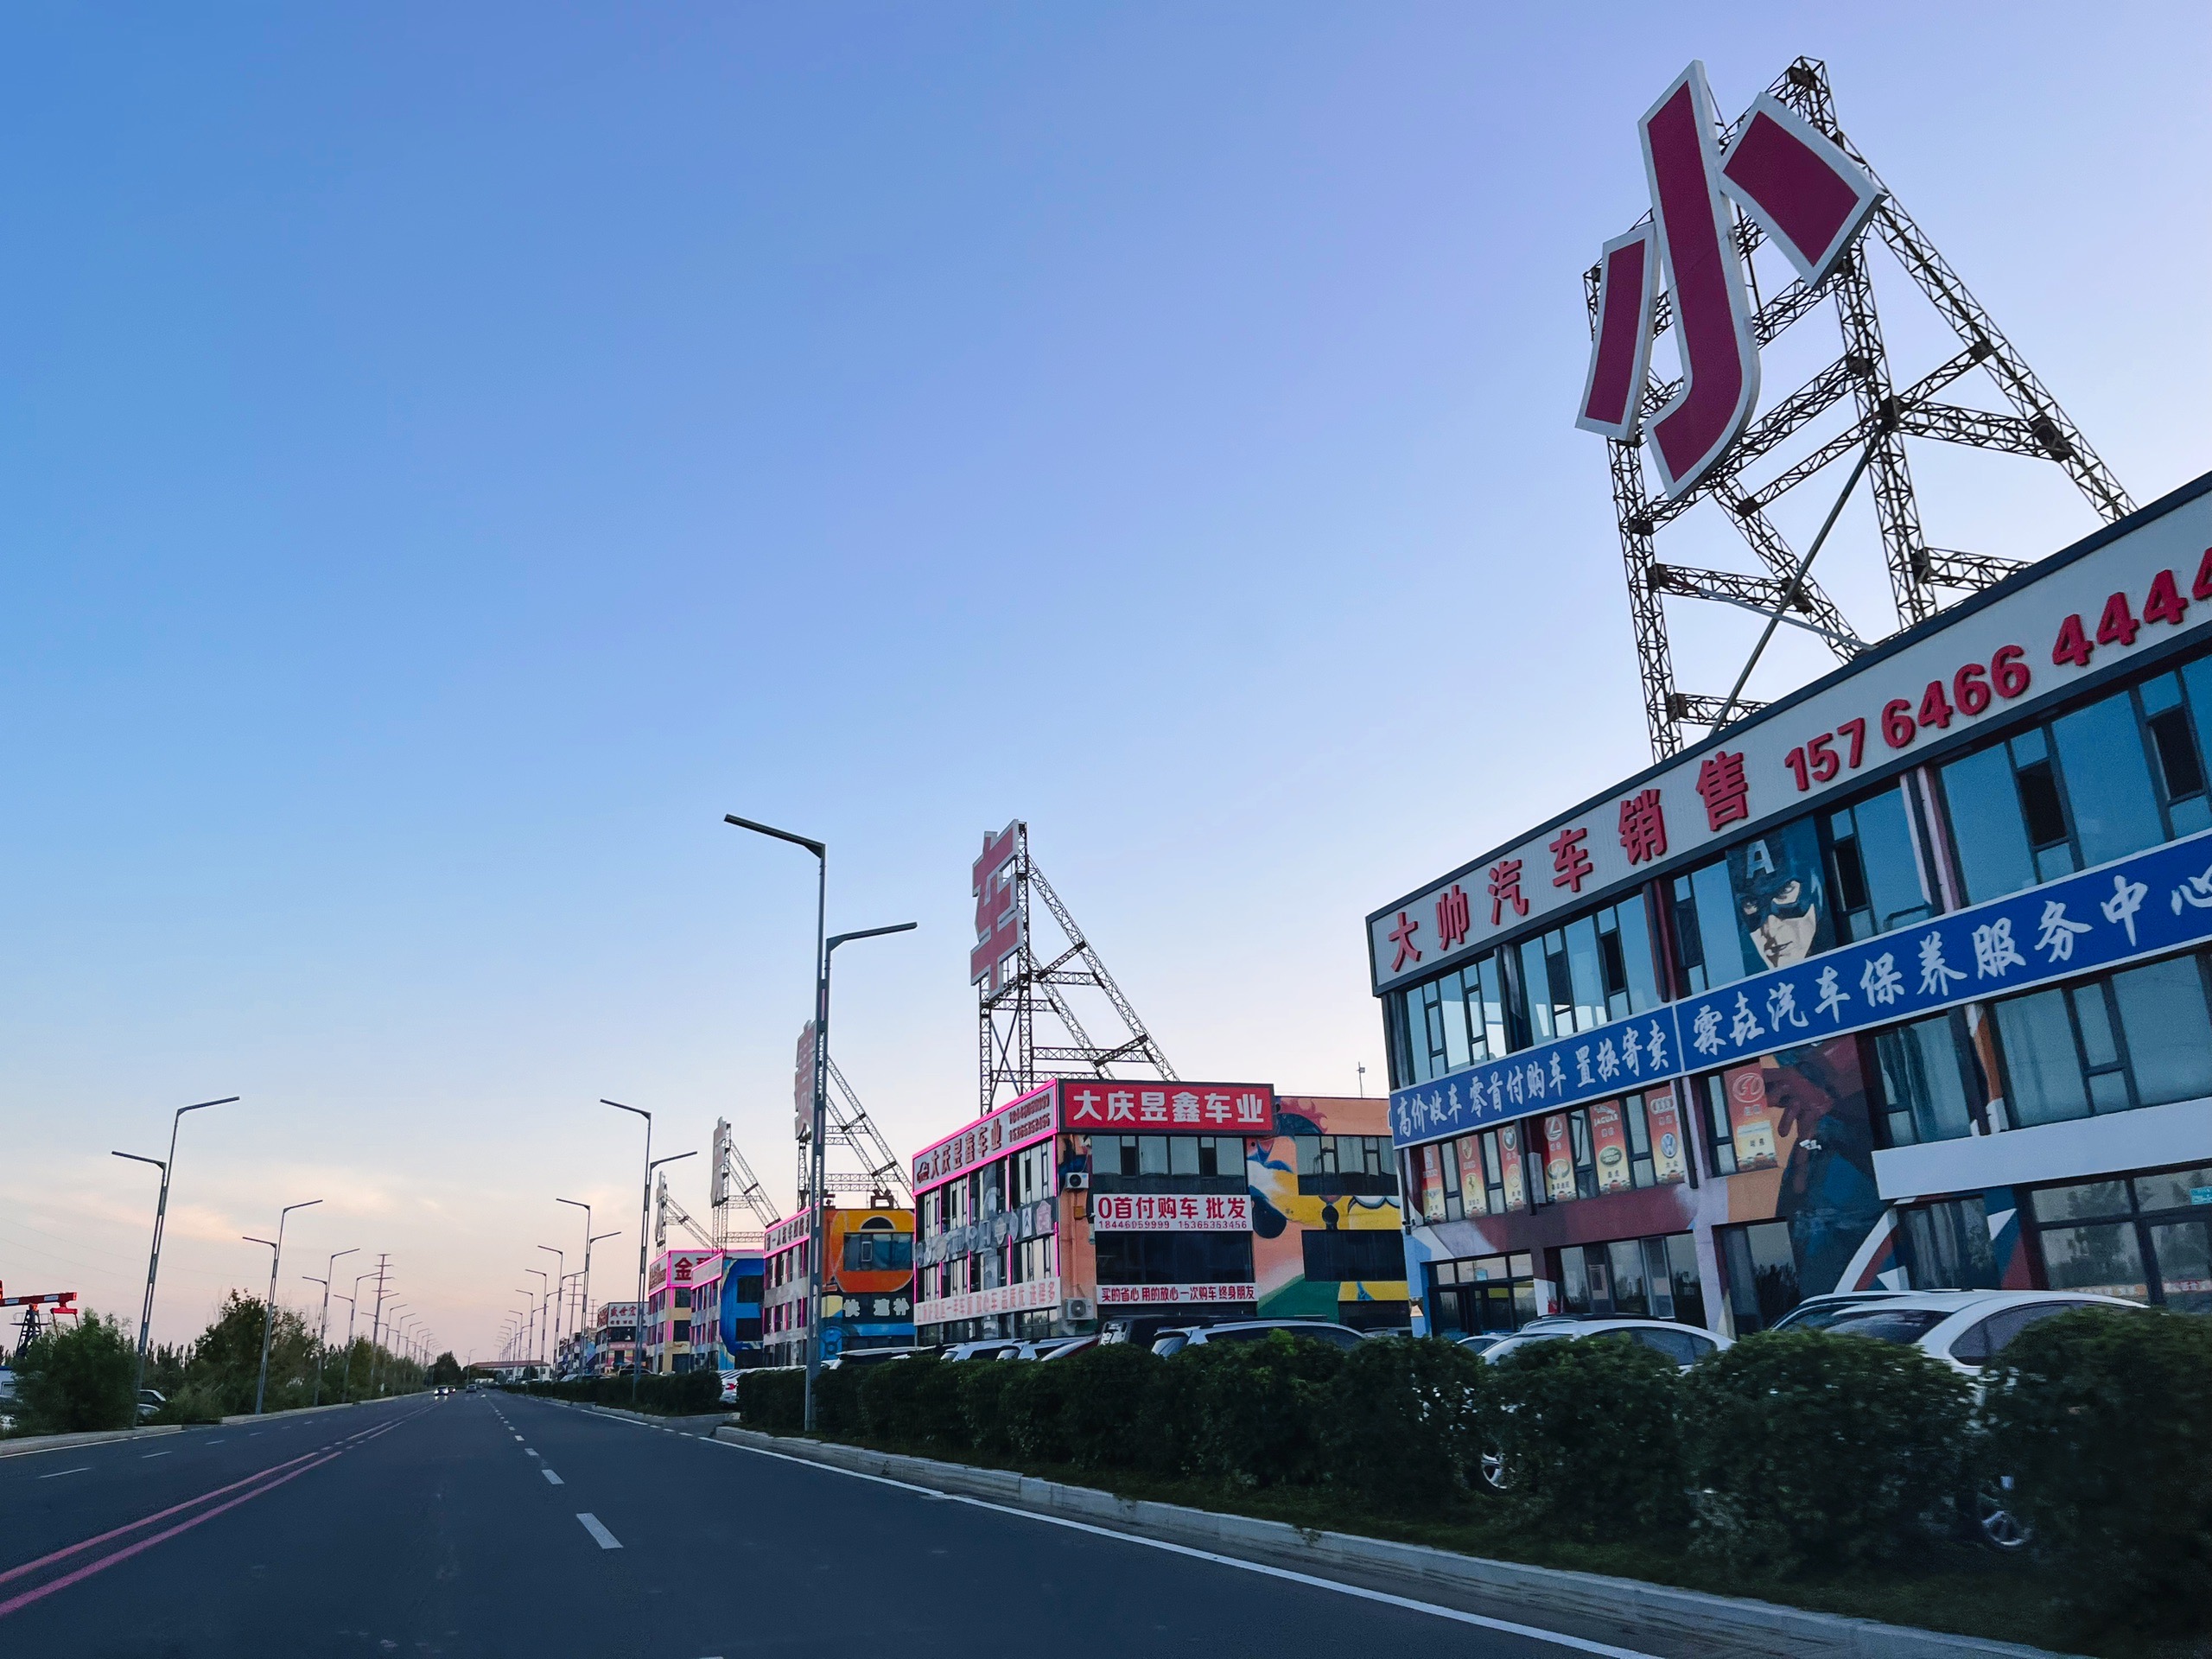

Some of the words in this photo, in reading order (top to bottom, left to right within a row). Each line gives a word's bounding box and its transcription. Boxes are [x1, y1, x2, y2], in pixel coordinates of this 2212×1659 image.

[1575, 59, 1889, 500] 小
[1388, 751, 1750, 973] 大帅汽车销售
[1784, 717, 1866, 791] 157
[1881, 645, 2032, 748] 6466
[1072, 1090, 1265, 1124] 大庆昱鑫车业
[1097, 1197, 1199, 1220] 0首付购车
[1205, 1197, 1247, 1219] 批发
[1101, 1287, 1140, 1303] 买的省心
[1141, 1287, 1179, 1302] 用的放心
[1179, 1286, 1217, 1301] 一次购车
[1218, 1285, 1255, 1300] 终身朋友
